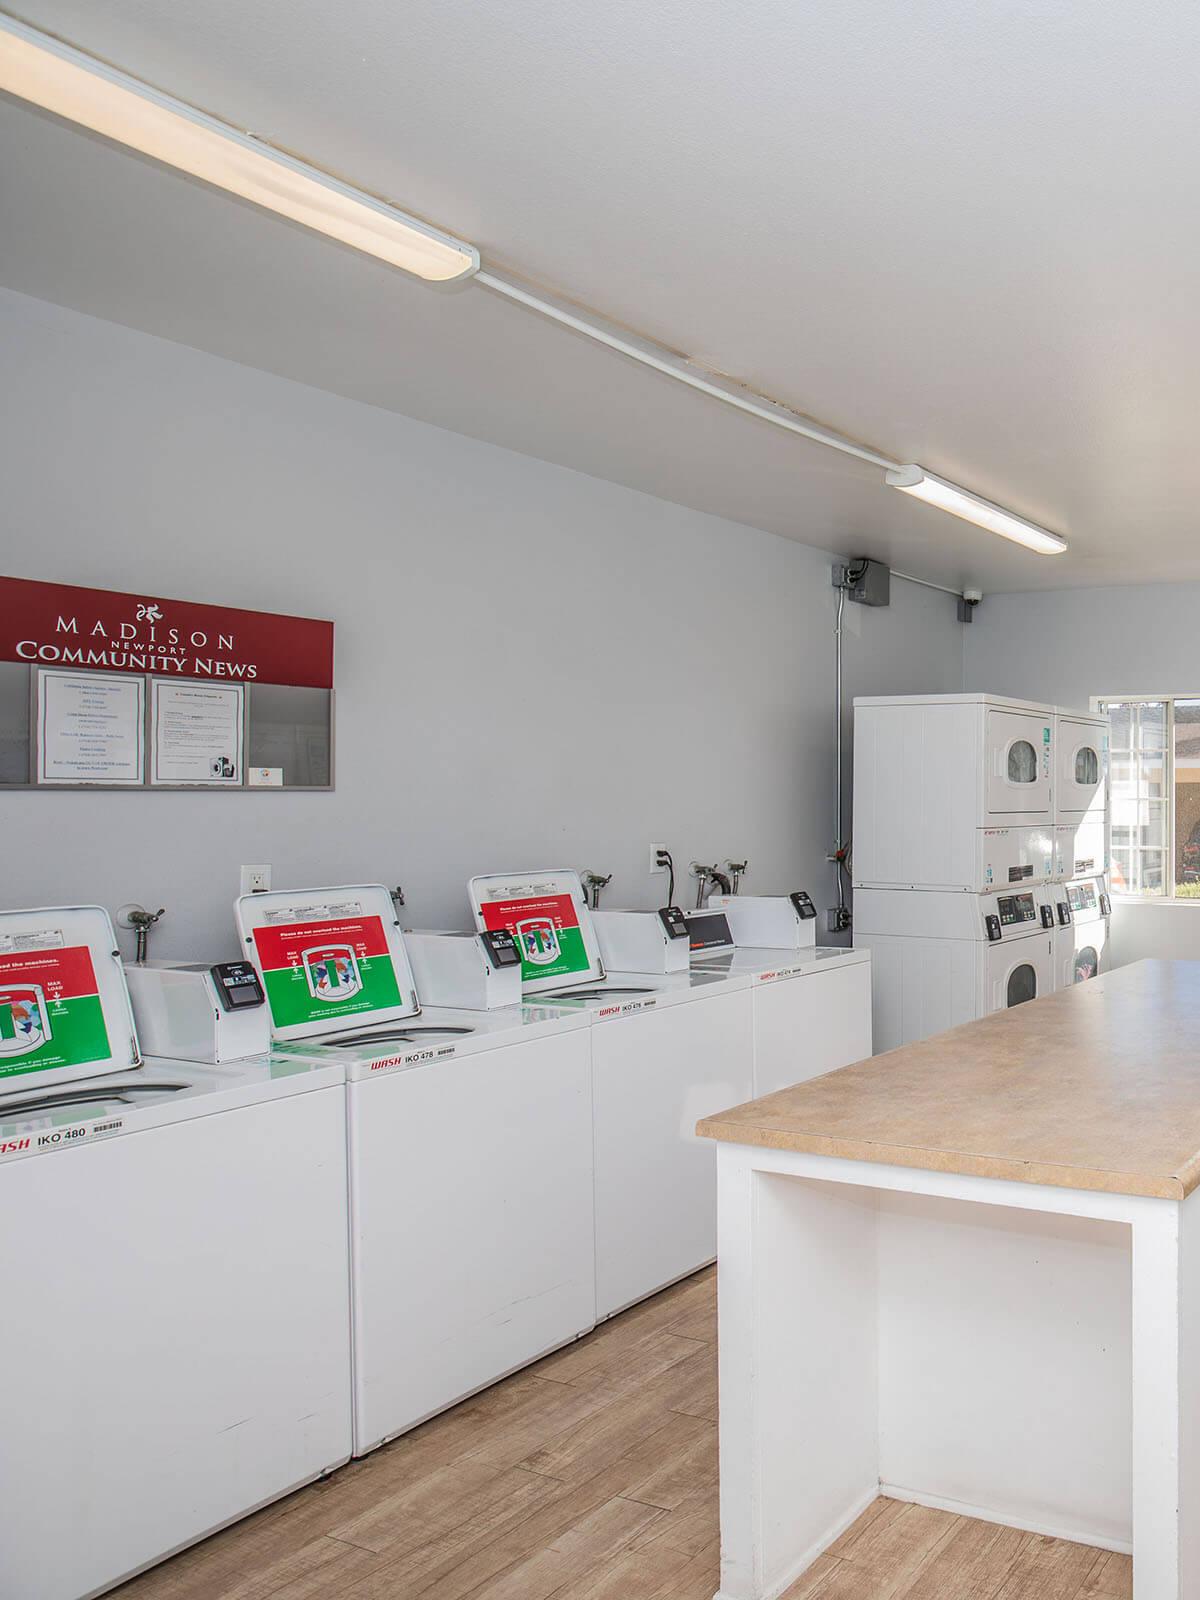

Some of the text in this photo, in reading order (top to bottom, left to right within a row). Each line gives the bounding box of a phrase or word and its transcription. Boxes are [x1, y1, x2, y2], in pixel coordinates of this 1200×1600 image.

[56, 615, 234, 650] MADISON
[16, 640, 257, 679] COMMUNITY NEWS
[111, 640, 186, 655] NEWPORT
[371, 1050, 434, 1070] WASH IKO 478
[0, 1127, 86, 1154] ASH IKO 480
